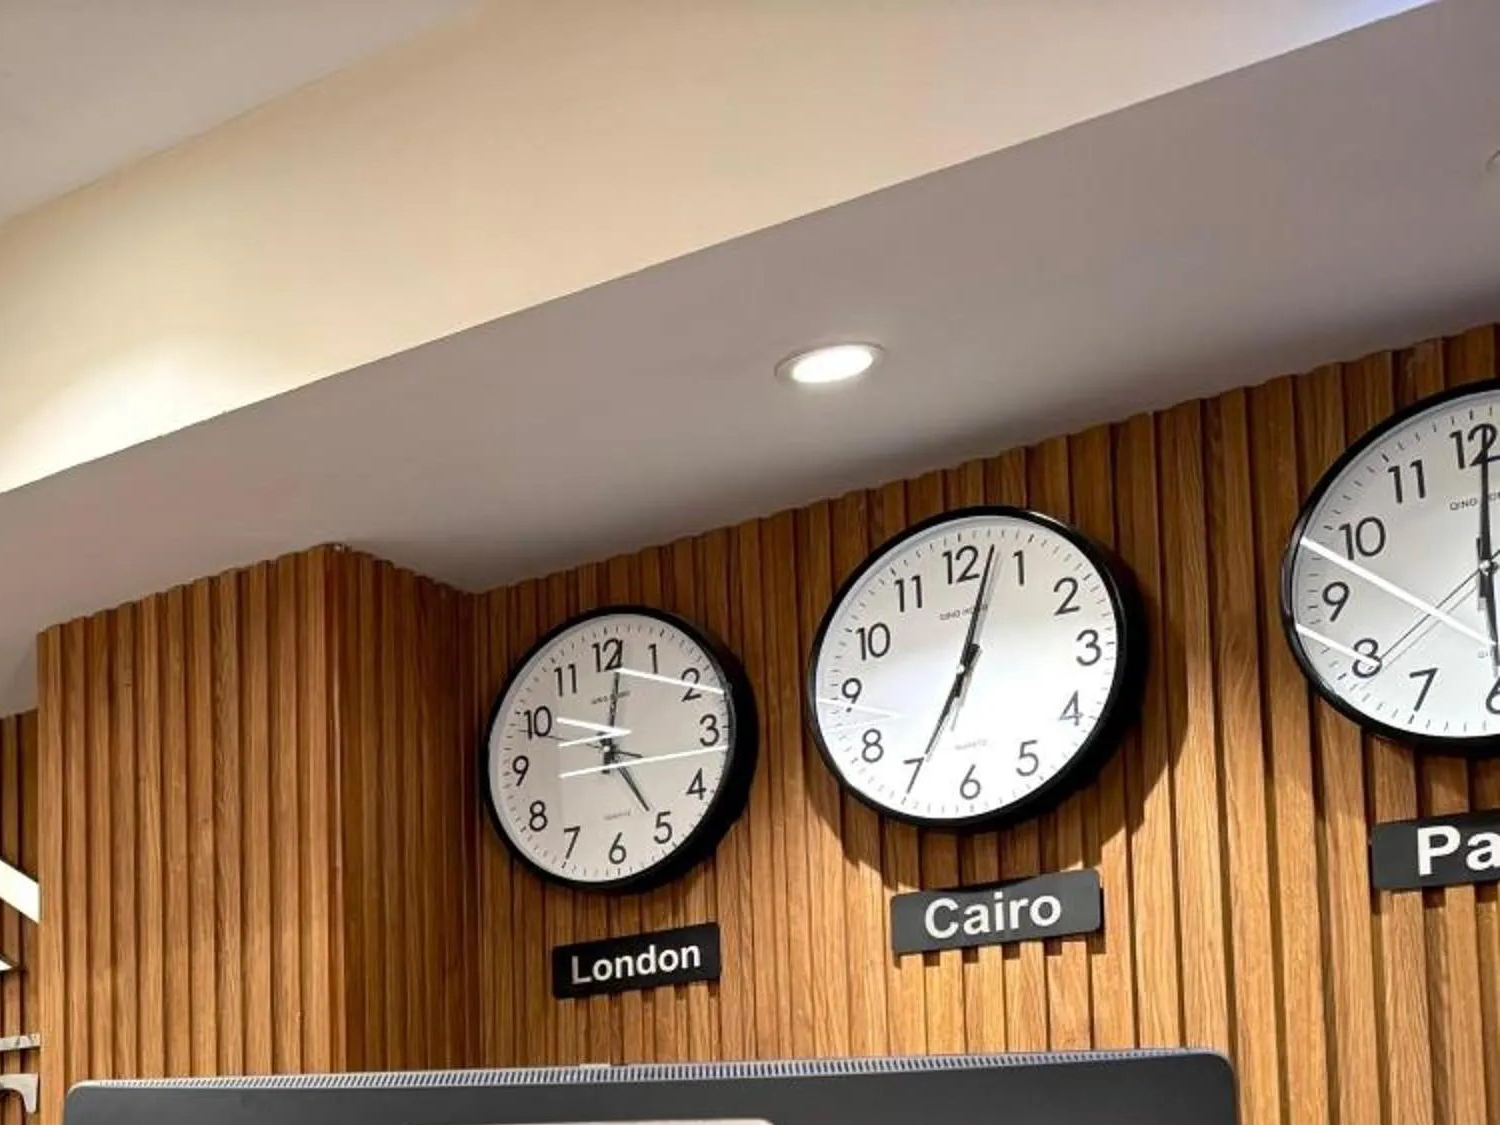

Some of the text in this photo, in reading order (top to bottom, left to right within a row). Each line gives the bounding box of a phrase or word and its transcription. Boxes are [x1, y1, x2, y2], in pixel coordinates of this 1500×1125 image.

[1450, 423, 1500, 470] 12
[1387, 459, 1426, 505] 11
[1338, 516, 1387, 561] 10
[942, 545, 980, 585] 12
[1013, 550, 1025, 586] 1
[895, 575, 924, 613] 11
[1053, 577, 1080, 616] 2
[1321, 581, 1350, 622] 9
[591, 638, 624, 673] 12
[647, 643, 659, 675] 1
[856, 622, 891, 661] 10
[1076, 629, 1102, 666] 3
[1351, 637, 1382, 679] 8
[554, 664, 578, 697] 11
[680, 667, 702, 703] 2
[841, 677, 862, 712] 9
[1409, 668, 1438, 712] 7
[523, 705, 553, 740] 10
[1059, 690, 1083, 726] 4
[699, 714, 719, 747] 3
[861, 729, 884, 763] 8
[512, 755, 530, 786] 9
[903, 757, 925, 794] 7
[1015, 740, 1039, 777] 5
[686, 768, 707, 801] 4
[959, 764, 982, 800] 6
[529, 800, 548, 831] 8
[653, 811, 673, 844] 5
[563, 826, 581, 859] 7
[608, 832, 627, 865] 6
[1417, 825, 1500, 877] Pa
[924, 892, 1062, 939] Cairo
[571, 943, 701, 985] London
